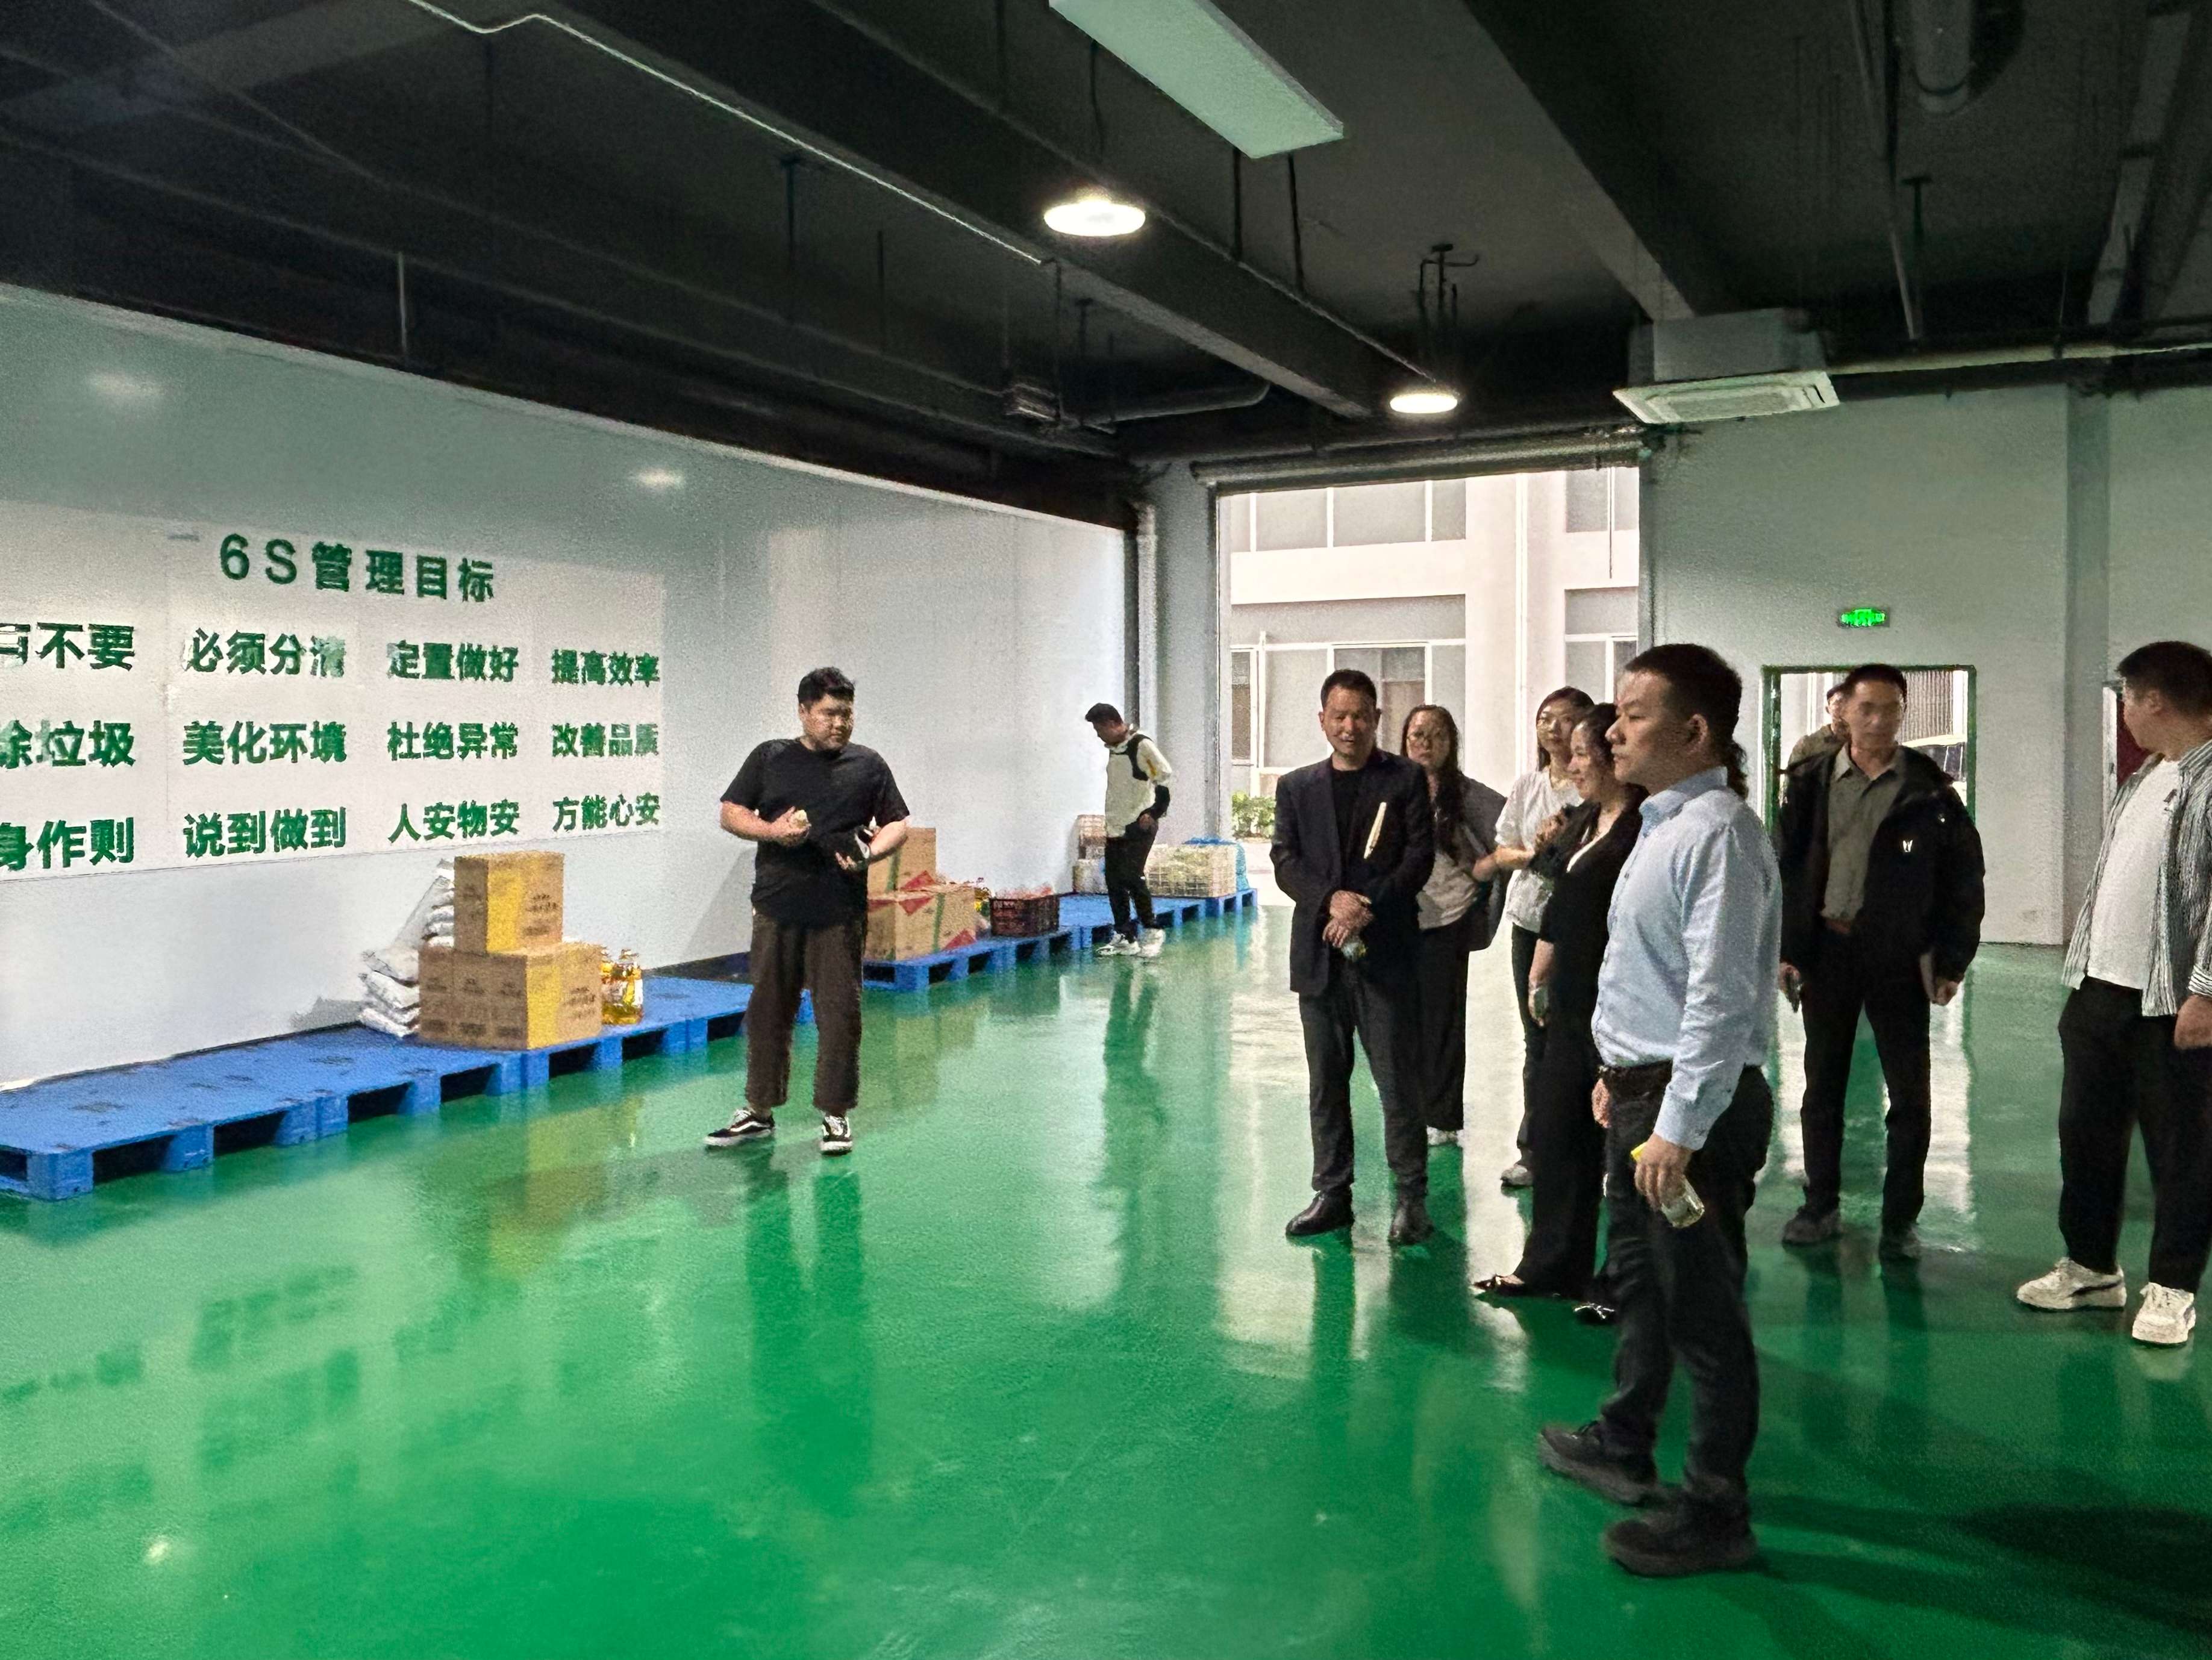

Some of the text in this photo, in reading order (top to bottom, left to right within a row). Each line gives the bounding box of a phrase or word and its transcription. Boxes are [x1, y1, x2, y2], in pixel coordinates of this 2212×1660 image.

[220, 533, 495, 602] 6S管理目标
[552, 649, 660, 687] 提高效率
[183, 720, 348, 766] 美化环境
[387, 722, 519, 761] 杜绝异常
[551, 722, 658, 757] 改善品质
[183, 807, 347, 858] 说到做到
[388, 799, 519, 843] 人安物安
[552, 792, 660, 832] 方能心安
